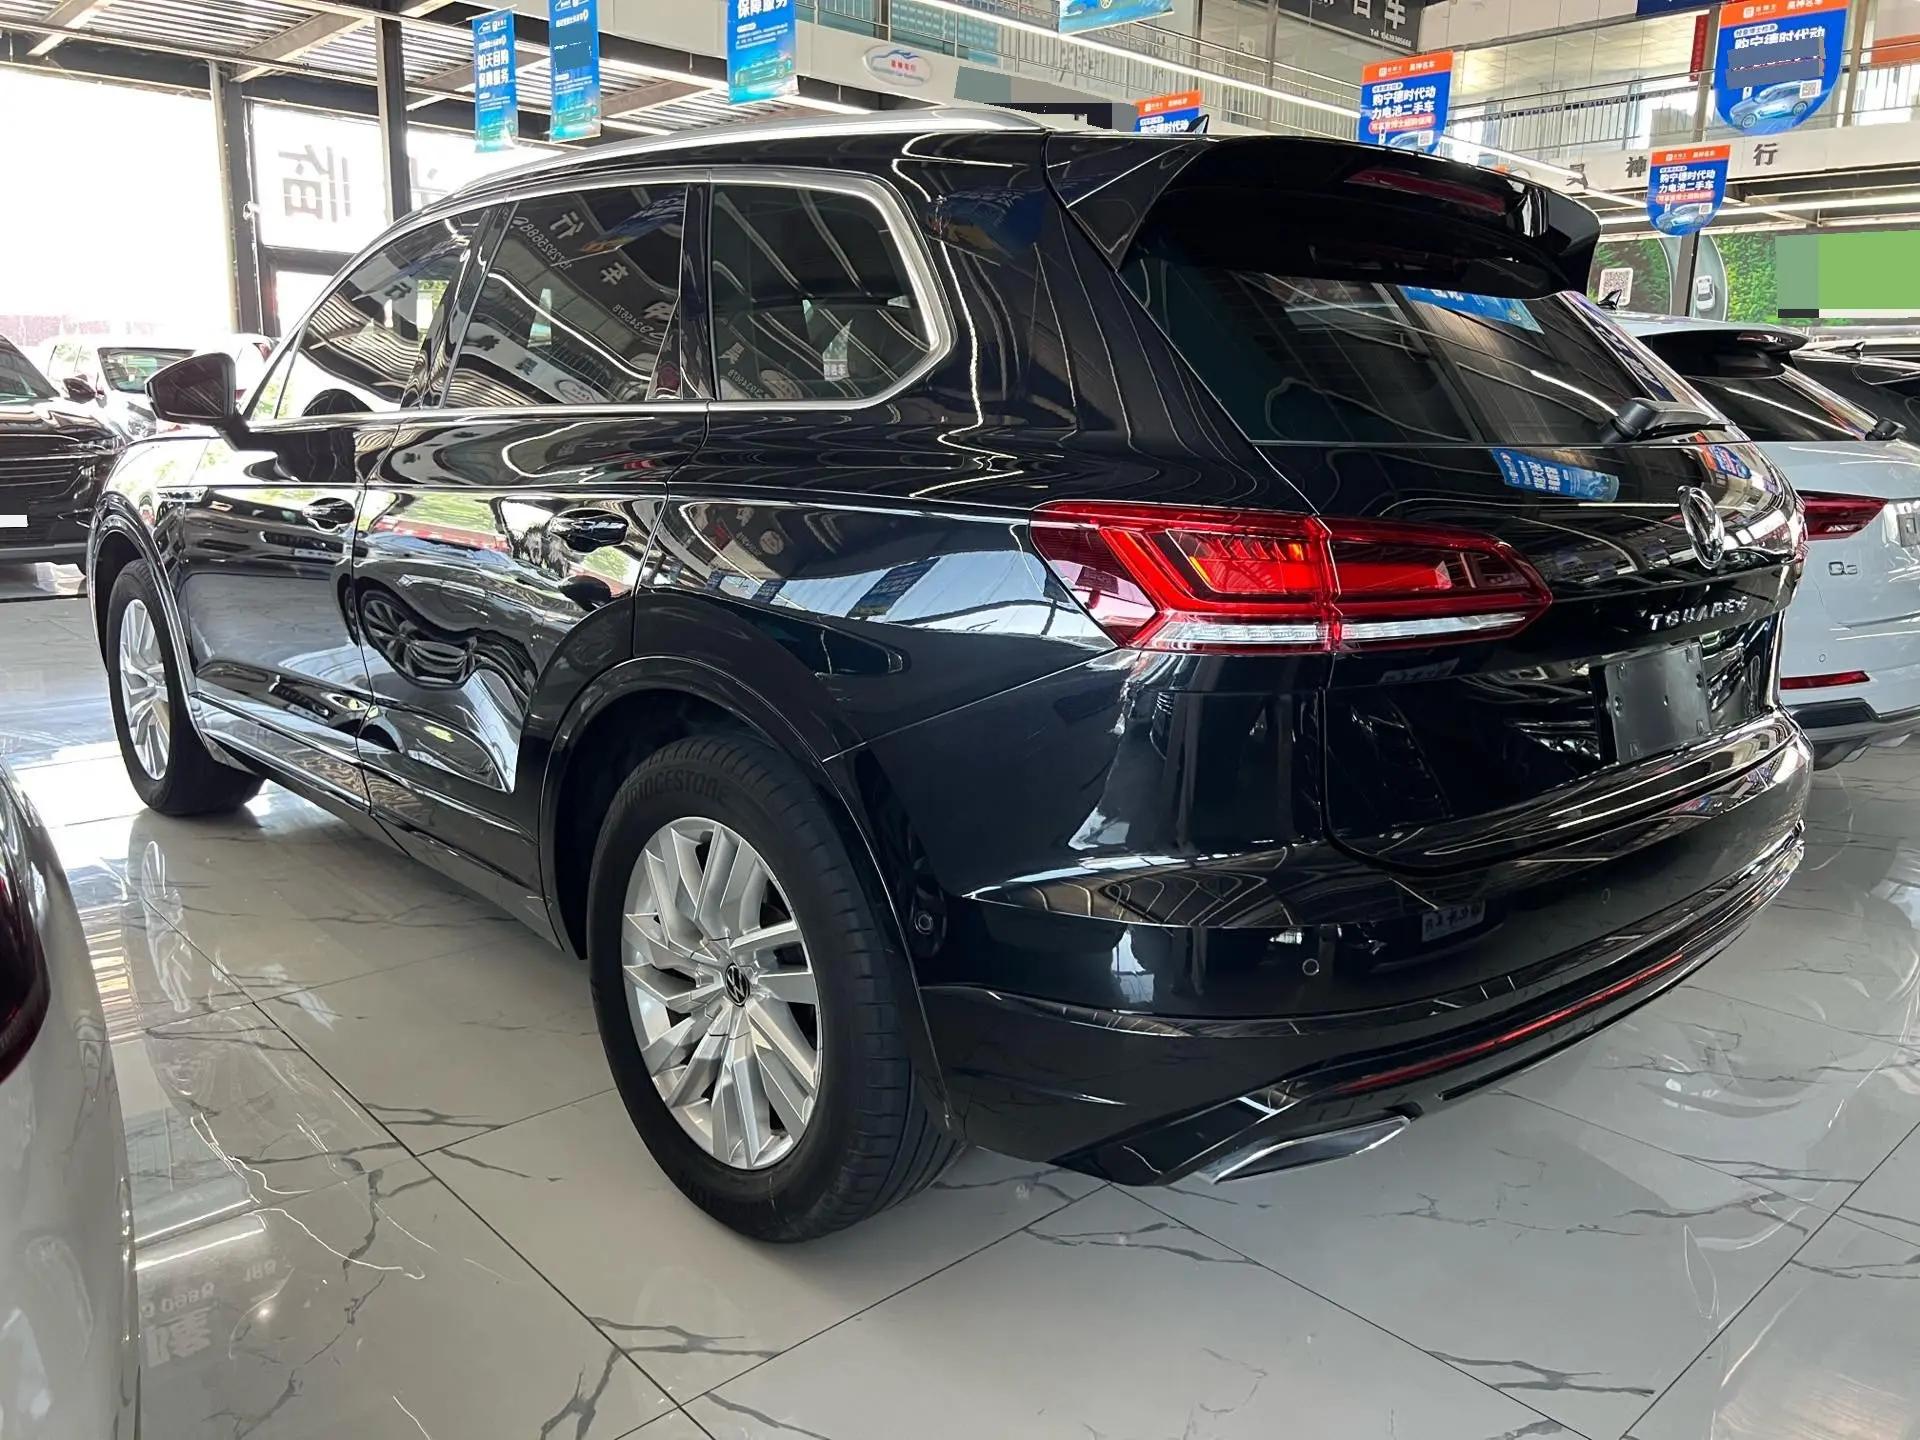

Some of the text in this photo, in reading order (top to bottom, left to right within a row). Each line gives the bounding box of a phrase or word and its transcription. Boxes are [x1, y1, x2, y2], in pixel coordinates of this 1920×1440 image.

[1372, 85, 1437, 106] 购宁德时代动
[1828, 561, 1858, 577] Q3
